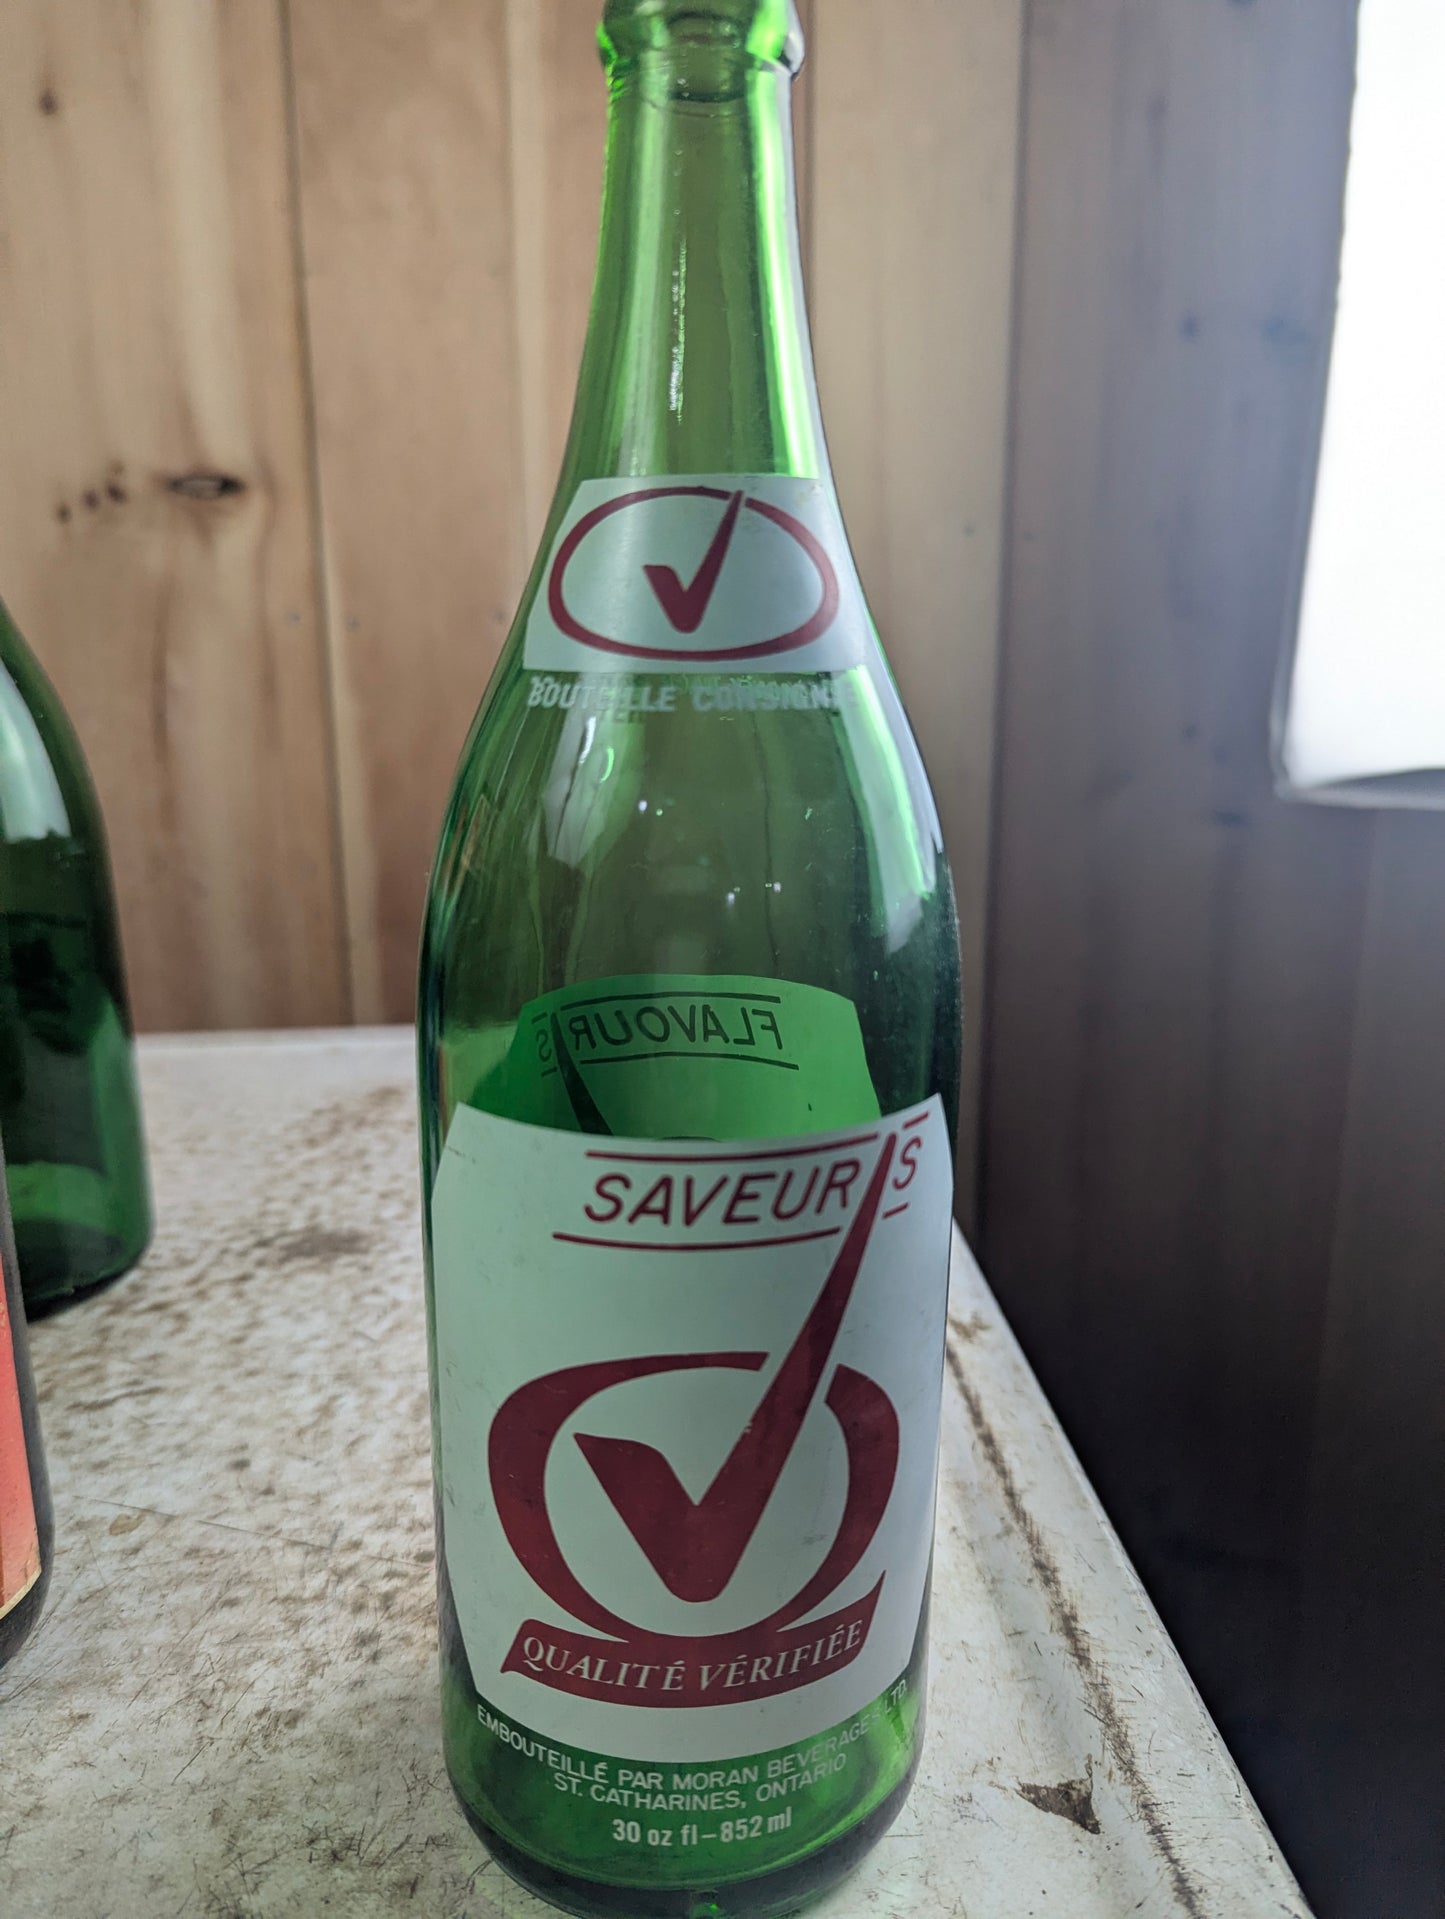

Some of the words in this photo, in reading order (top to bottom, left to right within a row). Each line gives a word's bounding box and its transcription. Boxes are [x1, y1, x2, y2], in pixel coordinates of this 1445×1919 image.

[584, 1158, 861, 1228] SAVEUR
[522, 1635, 685, 1690] QUALITÉ
[699, 1618, 862, 1691] VÉRIFIÉE
[477, 1704, 609, 1784] EMBOUTEILLÉ
[618, 1769, 664, 1791] PAR
[672, 1765, 760, 1791] MORAN
[554, 1773, 584, 1797] ST.
[590, 1784, 747, 1811] CATHARINES,
[756, 1753, 847, 1802] ONTARIO
[612, 1818, 642, 1843] 30
[647, 1828, 673, 1847] oz
[767, 1806, 792, 1833] ml
